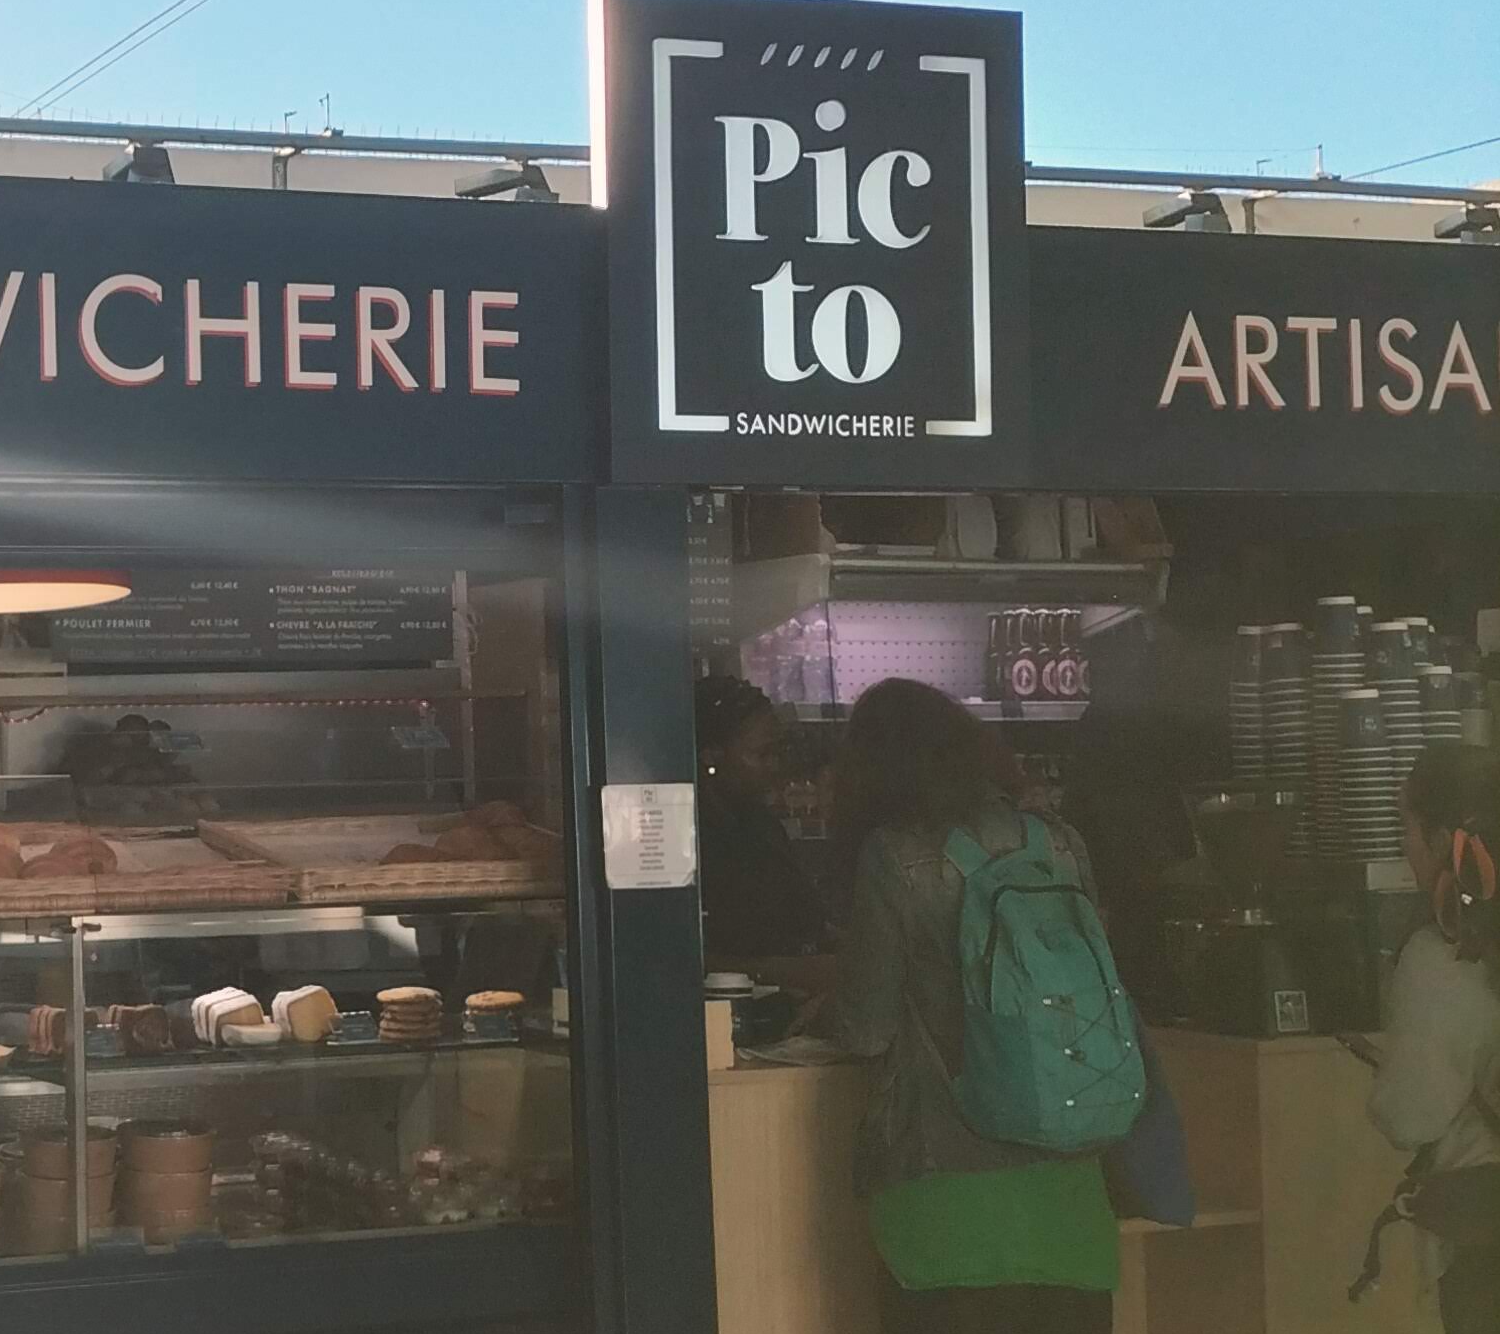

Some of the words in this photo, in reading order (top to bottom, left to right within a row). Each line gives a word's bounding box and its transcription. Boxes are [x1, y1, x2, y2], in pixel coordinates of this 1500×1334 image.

[714, 99, 932, 250] Pic
[750, 259, 903, 386] to
[1156, 308, 1500, 417] ARTISA
[735, 411, 916, 439] SANDWICHERIE
[62, 618, 103, 629] POULET
[106, 618, 152, 629] FERMIER
